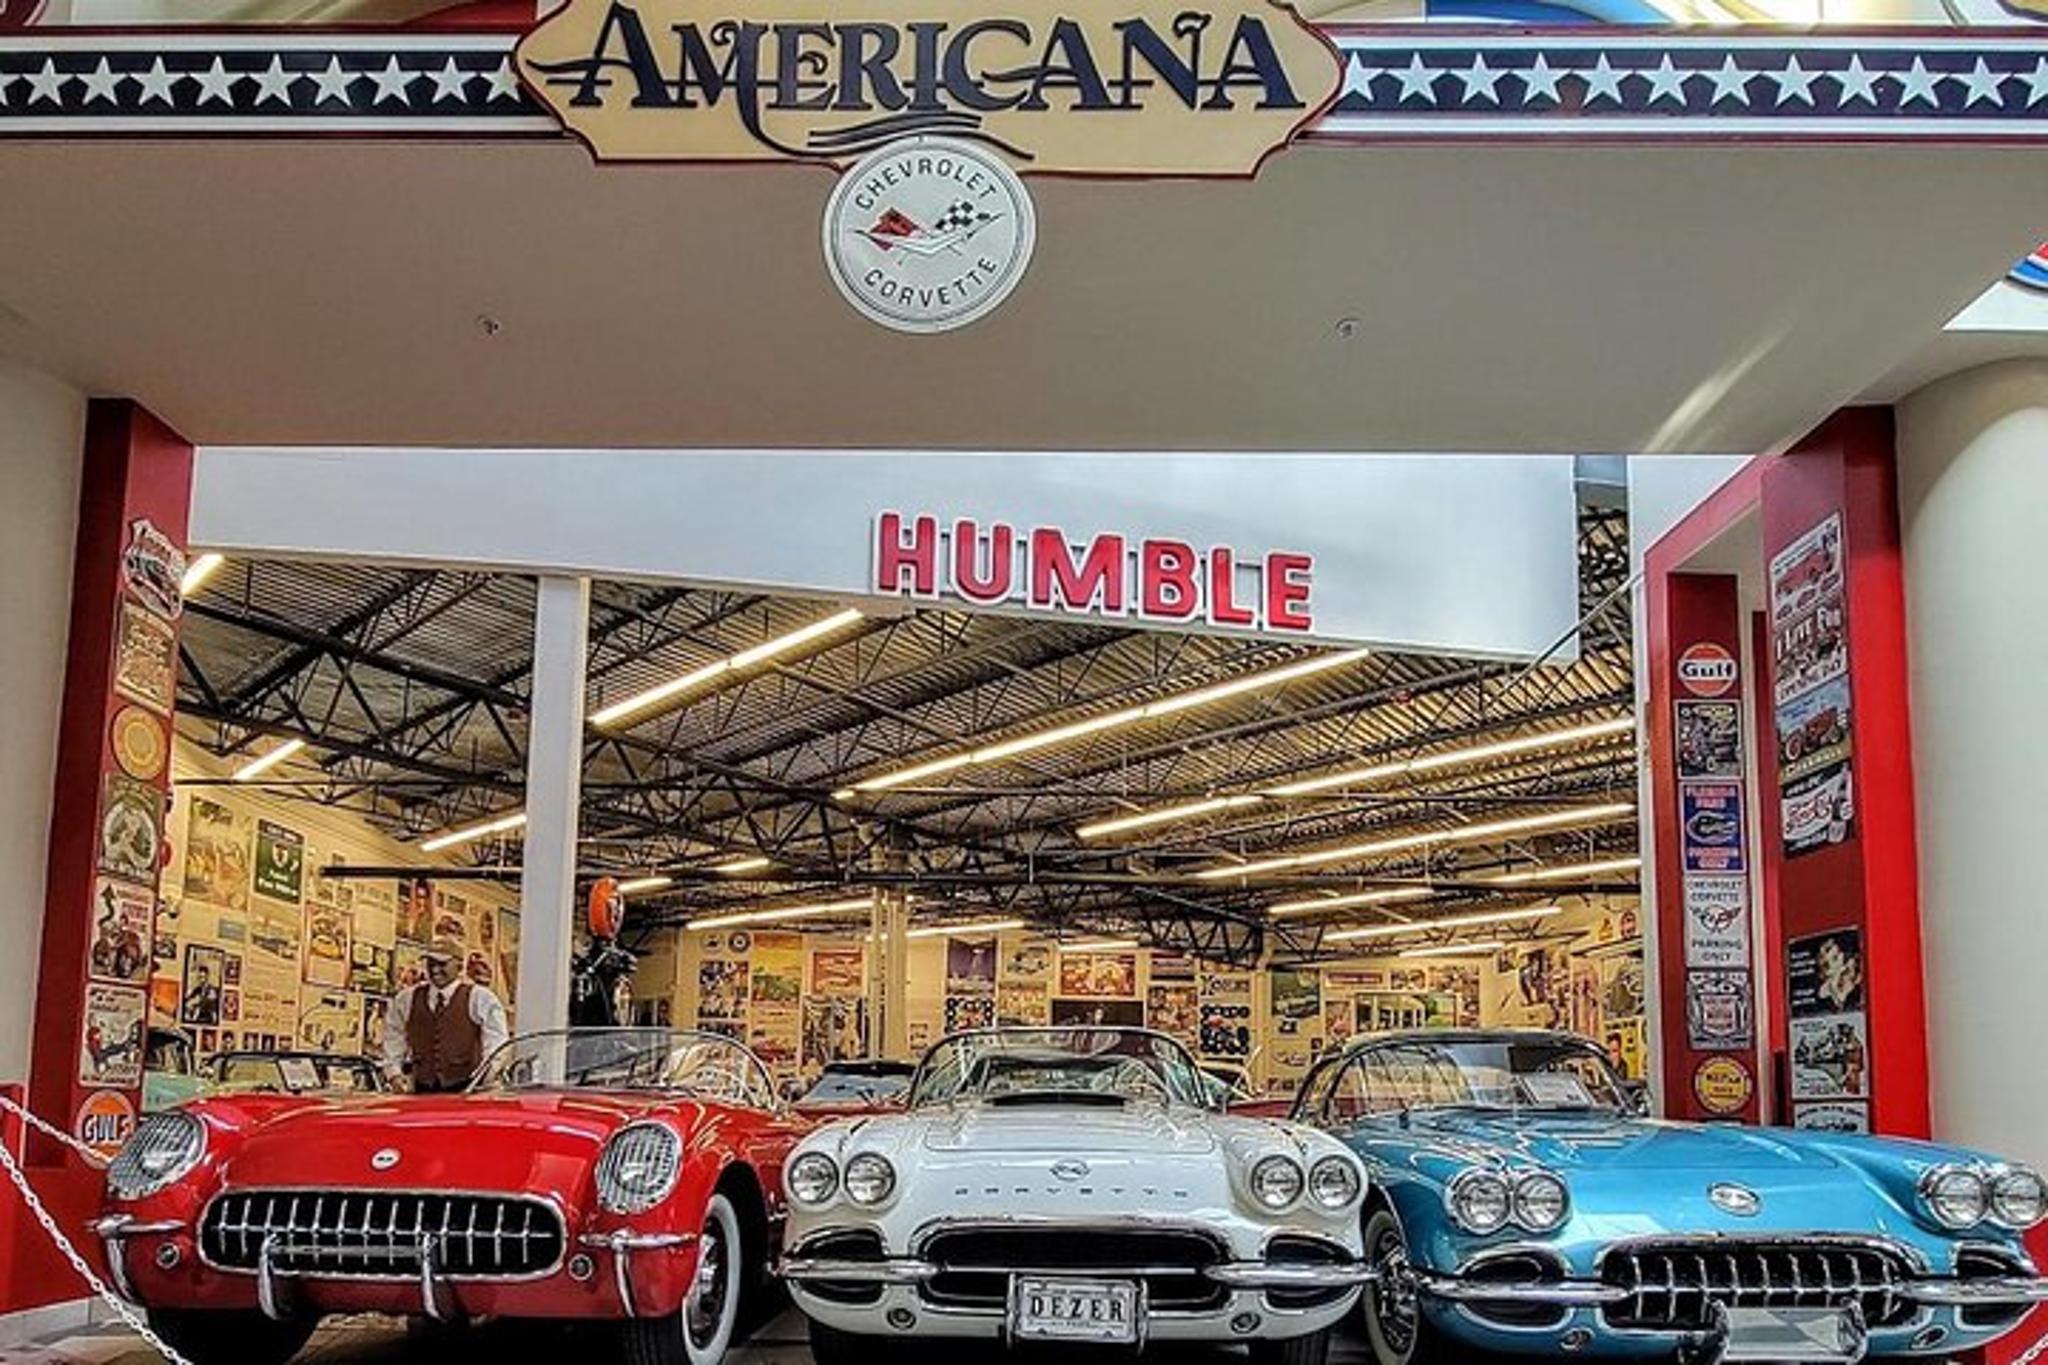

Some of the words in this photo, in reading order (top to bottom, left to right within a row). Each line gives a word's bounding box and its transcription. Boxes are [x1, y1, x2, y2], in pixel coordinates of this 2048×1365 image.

[526, 1, 1306, 155] AMERICANA
[855, 158, 997, 211] CHEVROLET
[863, 257, 998, 308] CORVETTE
[875, 511, 1314, 632] HUMBLE
[1681, 662, 1733, 677] Gulf
[1689, 880, 1742, 890] CHEVROLET
[1691, 892, 1740, 903] CORVETTE
[1691, 938, 1742, 950] PARKING
[1701, 952, 1732, 962] ONLY
[82, 1113, 132, 1143] GULF
[1030, 1296, 1123, 1321] DEZER
